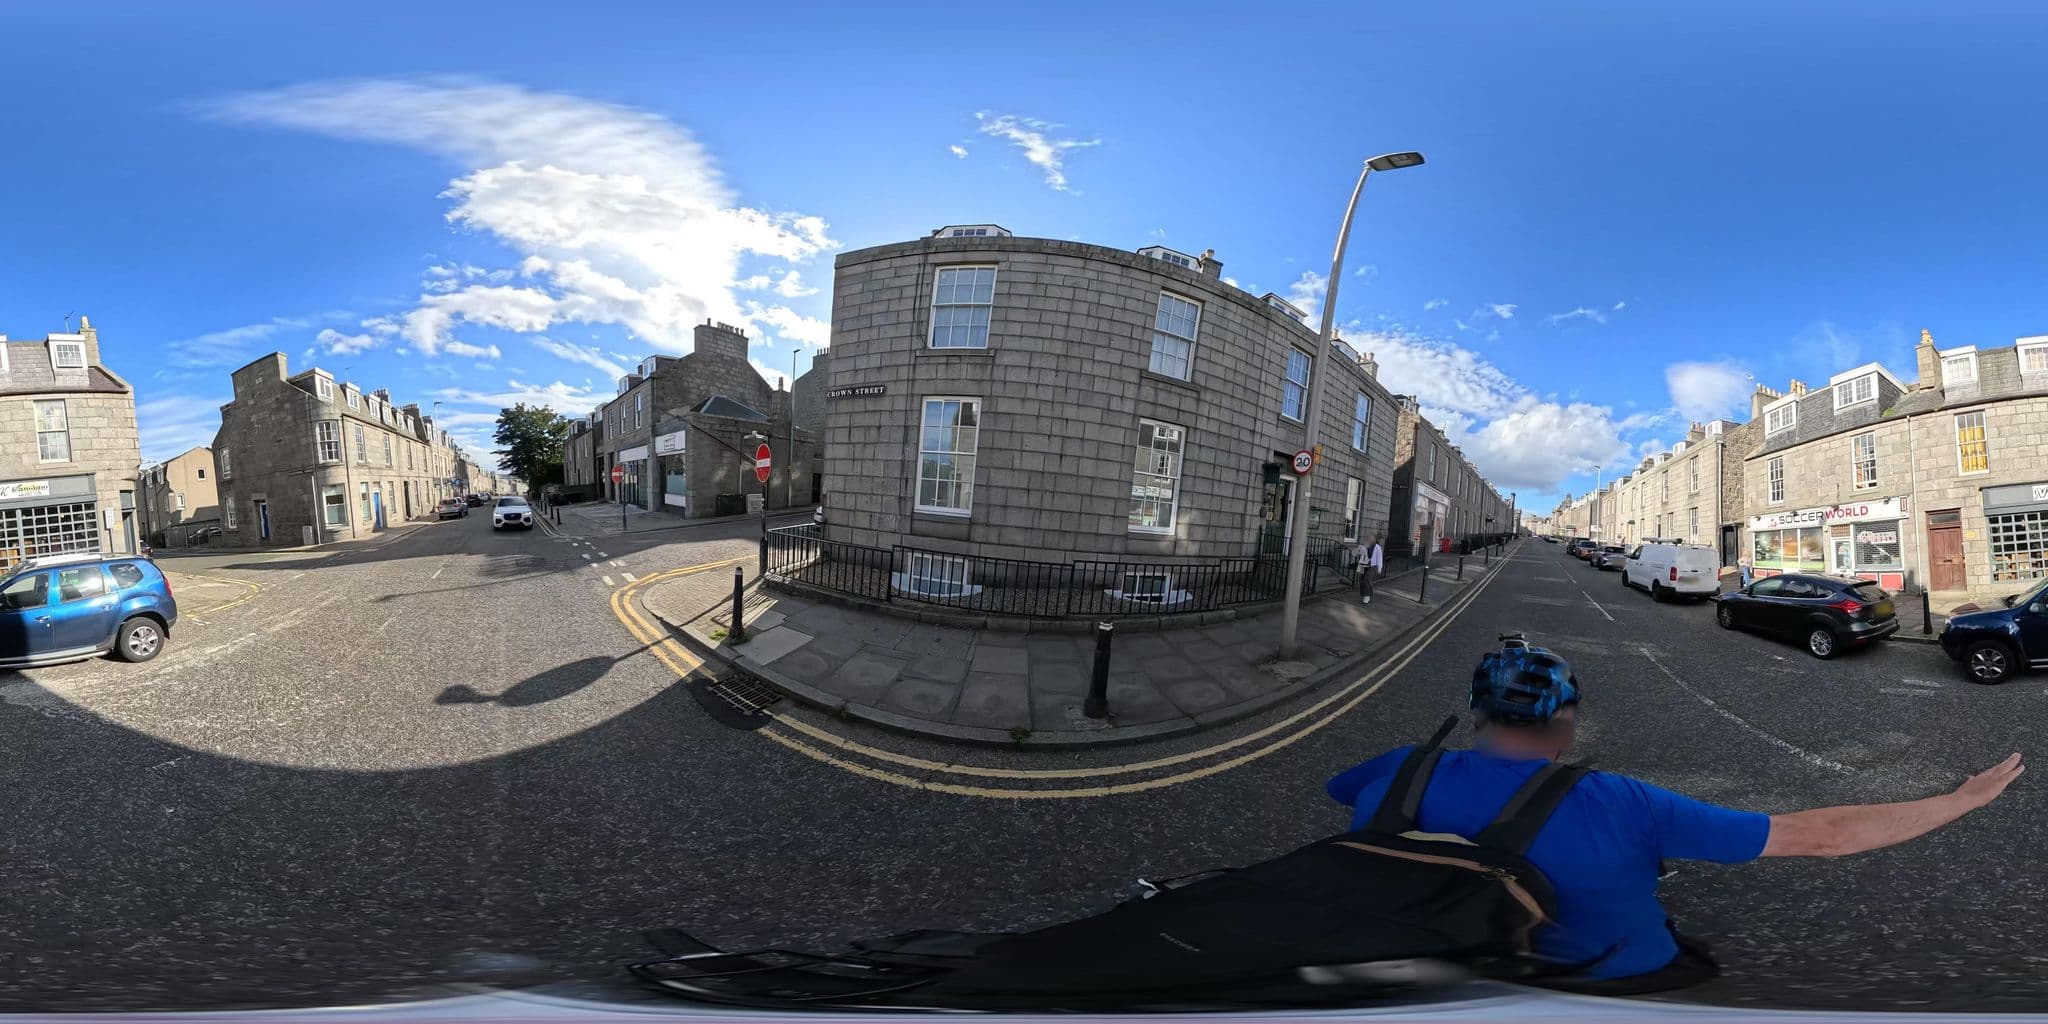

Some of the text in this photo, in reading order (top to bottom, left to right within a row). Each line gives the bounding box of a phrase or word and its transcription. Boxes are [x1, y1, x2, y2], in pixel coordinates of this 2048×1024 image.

[826, 386, 885, 398] CROWN STREET
[1296, 457, 1311, 467] 20
